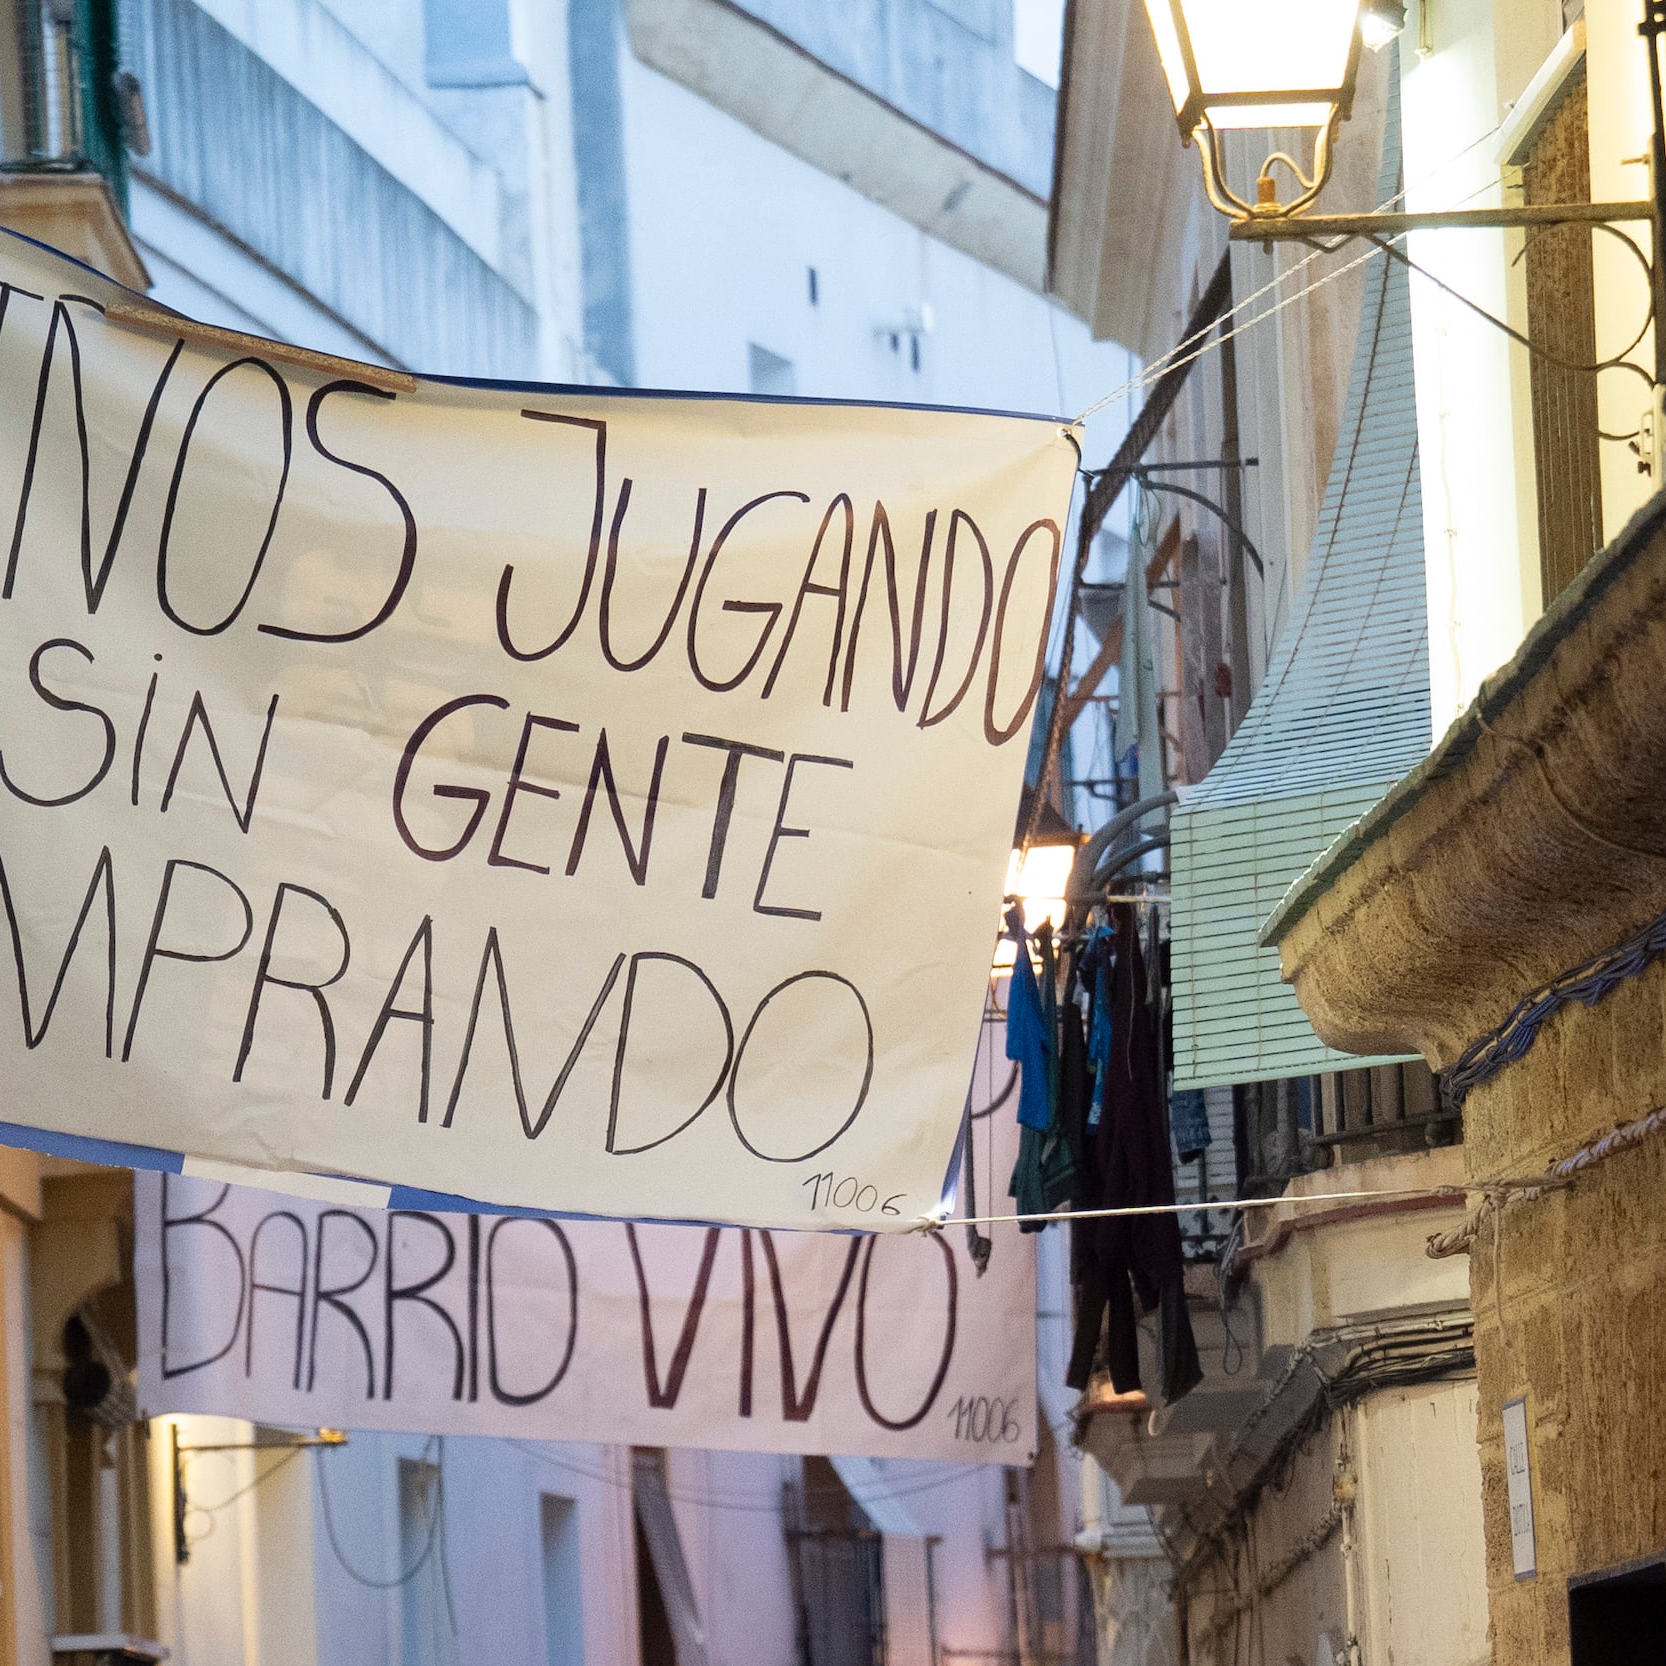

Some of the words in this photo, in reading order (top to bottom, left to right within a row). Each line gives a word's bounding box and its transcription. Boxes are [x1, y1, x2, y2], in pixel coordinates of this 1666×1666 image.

[497, 408, 1062, 745] JUGANDO
[393, 694, 855, 922] GENTE
[160, 1170, 578, 1406] BARRIO
[624, 1220, 959, 1432] VIVO
[802, 1171, 908, 1216] 11006
[946, 1395, 1021, 1444] 11006
